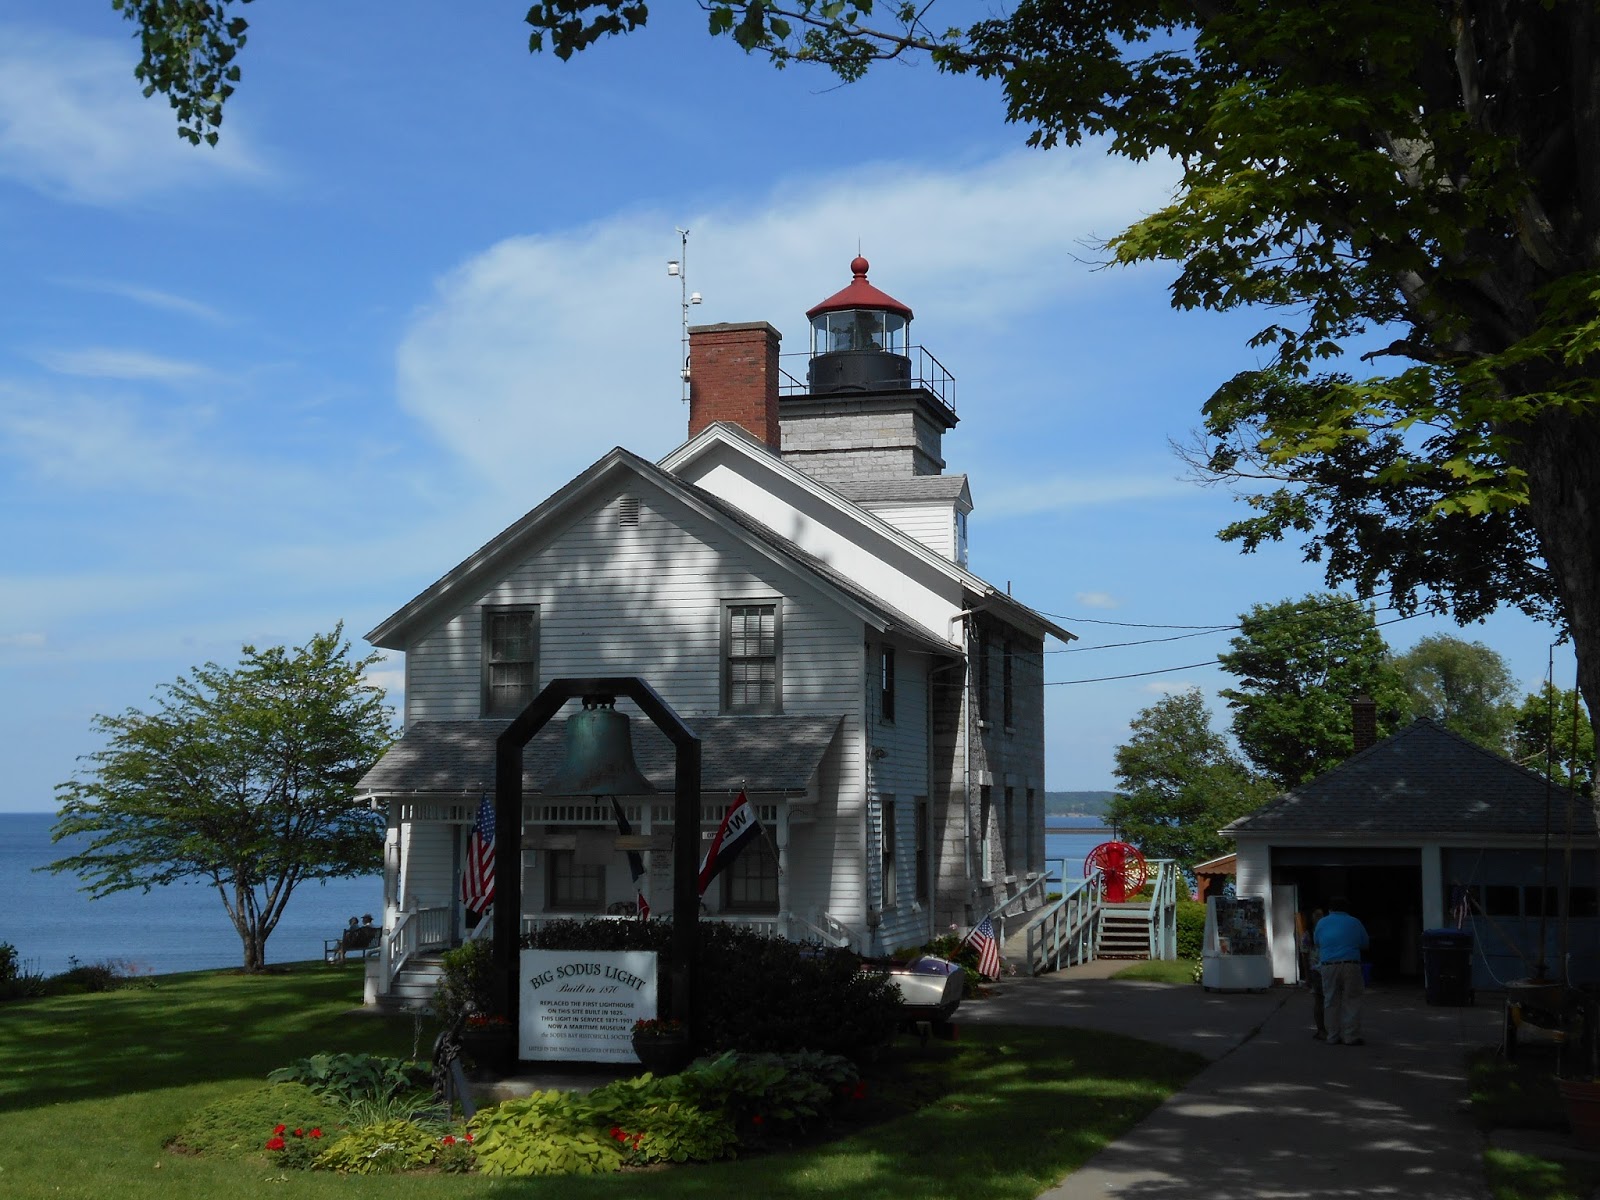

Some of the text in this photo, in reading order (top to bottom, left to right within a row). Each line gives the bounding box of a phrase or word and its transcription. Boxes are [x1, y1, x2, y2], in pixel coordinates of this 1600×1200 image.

[530, 963, 647, 991] BIG SODUS LIGHT
[556, 983, 585, 993] Built
[586, 985, 596, 993] in
